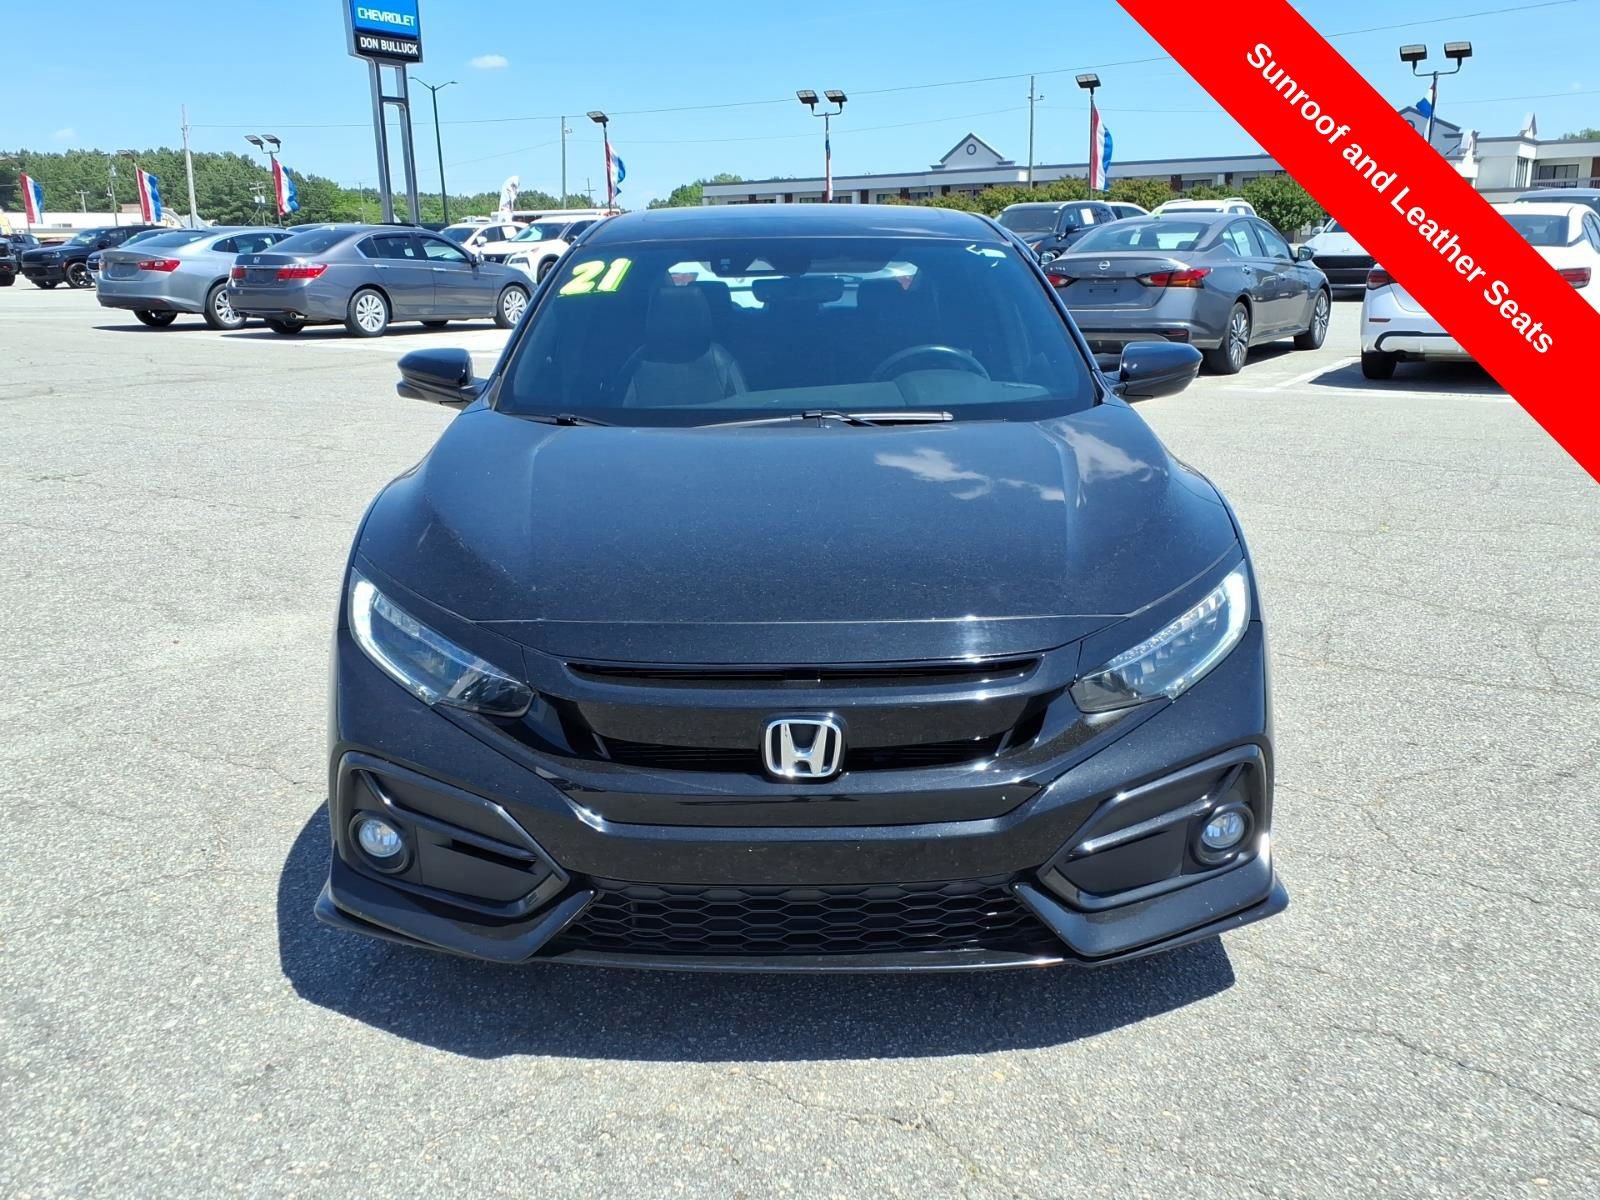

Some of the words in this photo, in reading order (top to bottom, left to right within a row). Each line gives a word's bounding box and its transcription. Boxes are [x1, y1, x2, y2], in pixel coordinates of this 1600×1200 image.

[357, 7, 415, 26] CHEVROLET
[360, 37, 379, 49] DON
[381, 40, 418, 55] BULLUCK
[559, 257, 631, 296] 21
